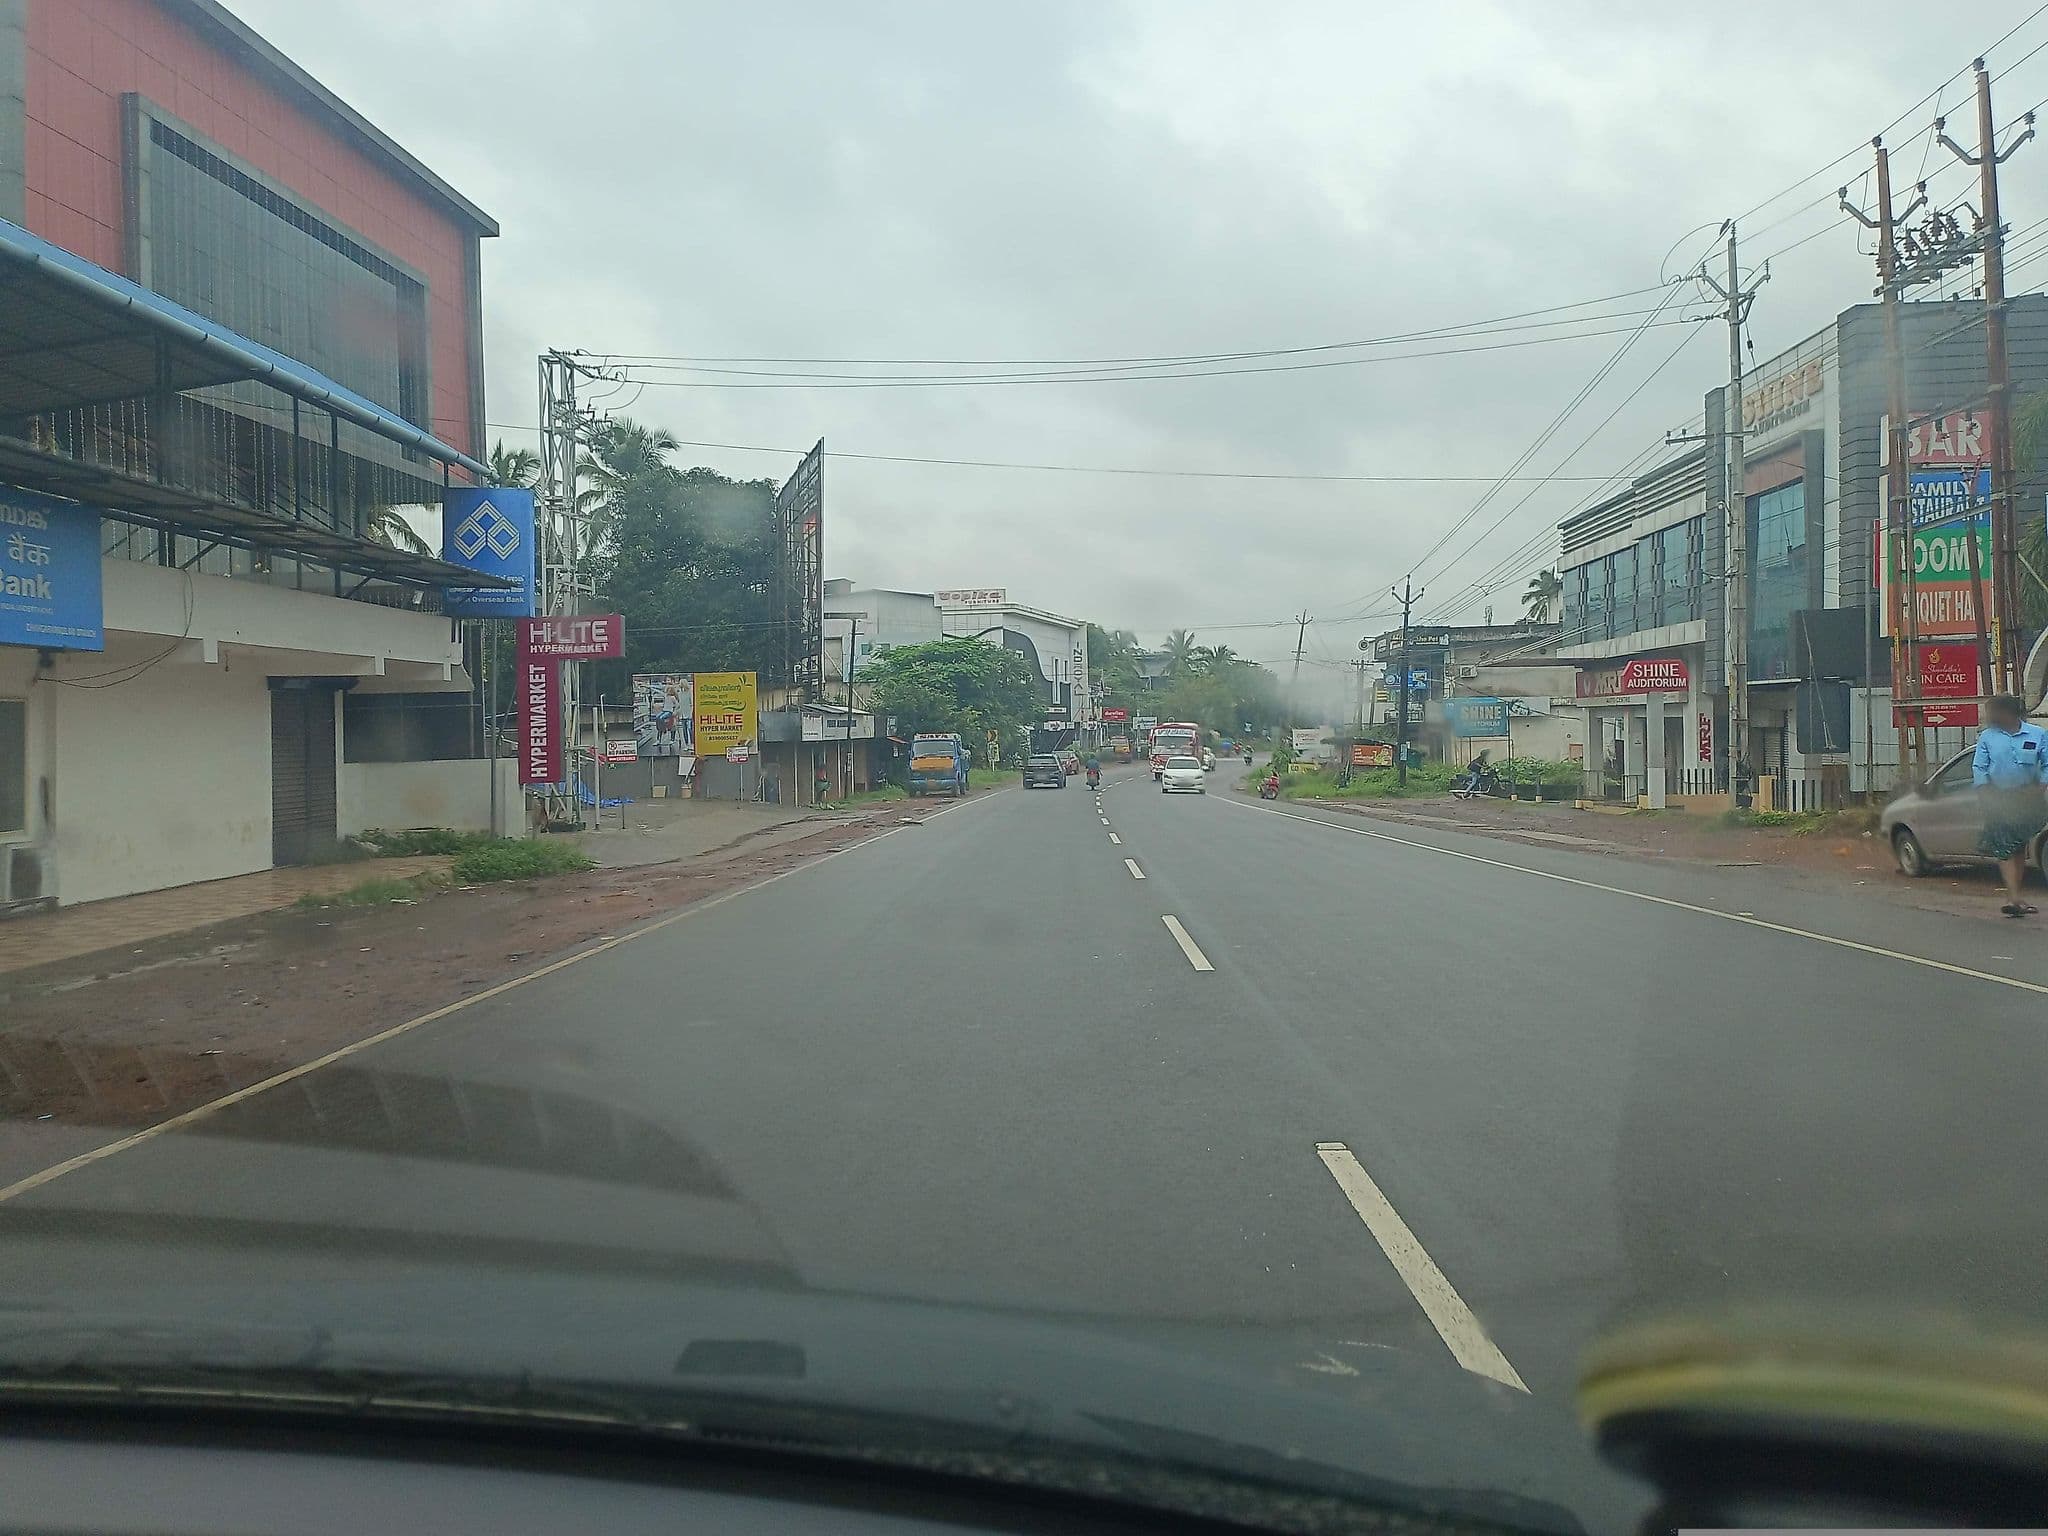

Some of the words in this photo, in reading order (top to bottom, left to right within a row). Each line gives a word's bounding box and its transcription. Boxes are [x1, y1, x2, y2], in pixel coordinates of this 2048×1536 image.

[1910, 481, 1972, 498] AMILY
[530, 643, 609, 655] HYPERMARKET
[1633, 663, 1680, 678] SHINE
[1627, 678, 1687, 689] AUDITORIUM
[1936, 673, 1967, 684] CARE
[1462, 705, 1501, 719] SHINE
[529, 664, 548, 778] HYPERMARKET
[1699, 713, 1712, 762] MRF
